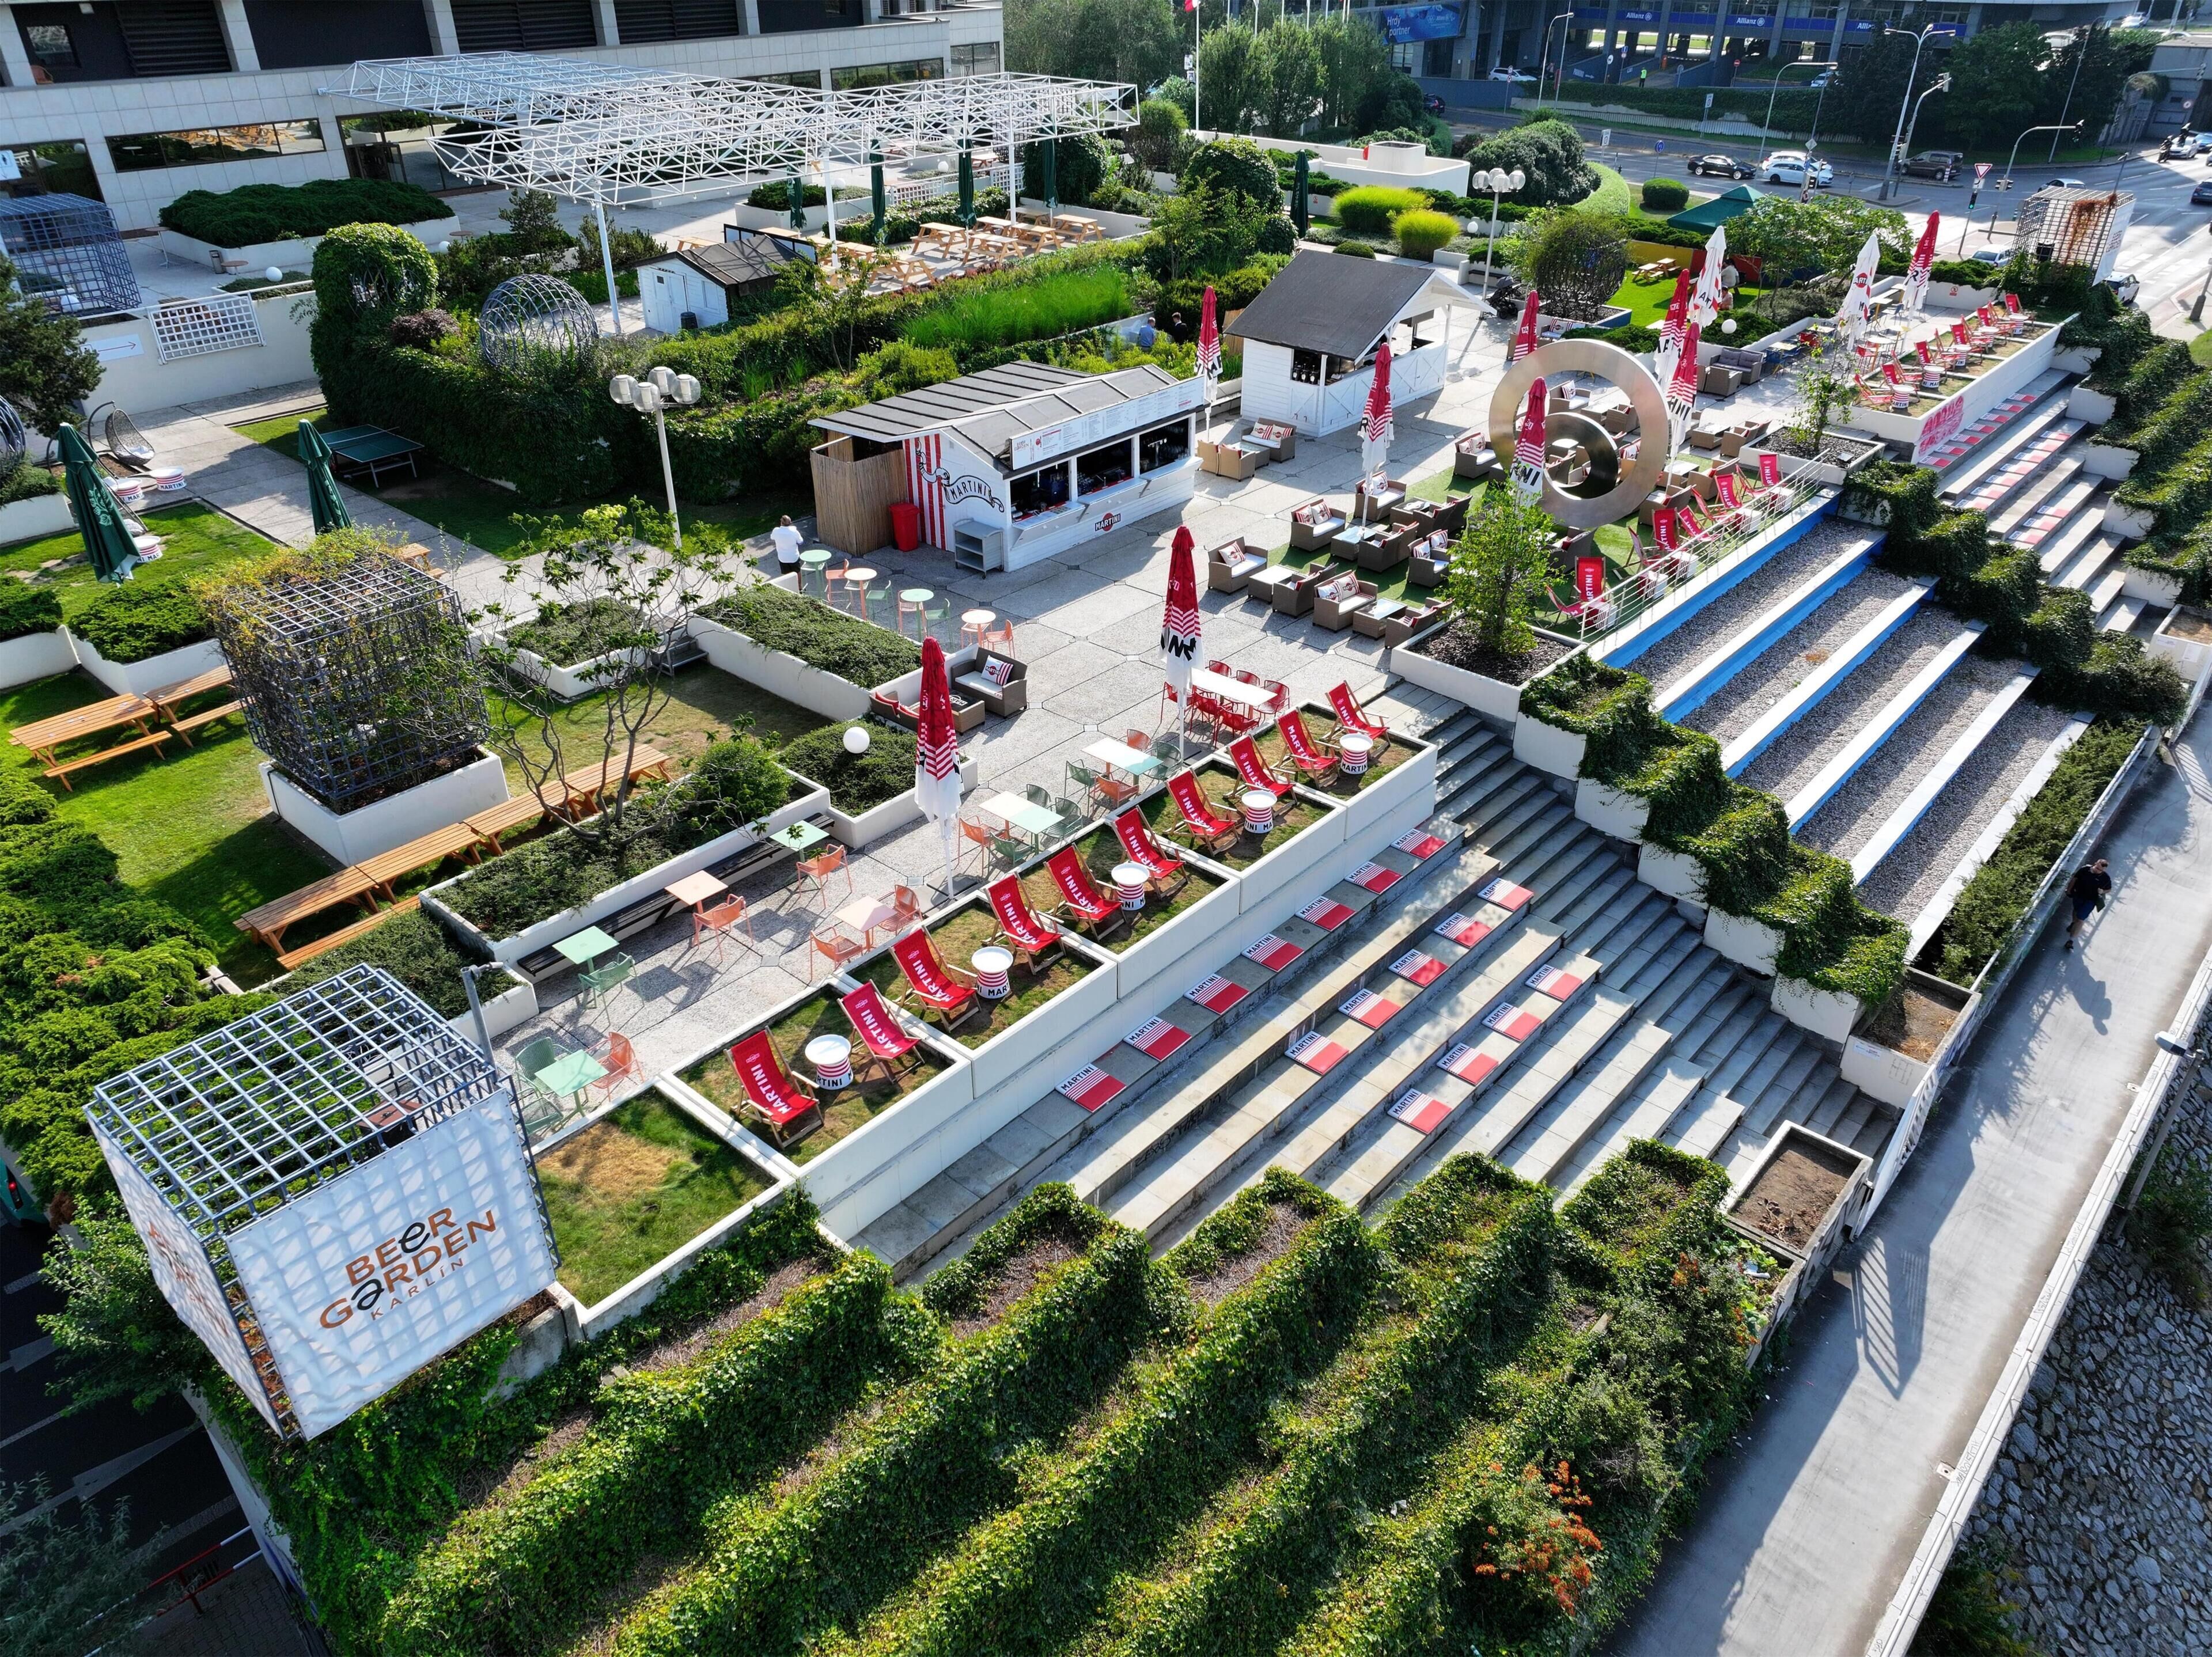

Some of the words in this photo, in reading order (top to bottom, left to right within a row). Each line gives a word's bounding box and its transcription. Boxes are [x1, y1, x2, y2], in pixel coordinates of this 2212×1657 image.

[1387, 15, 1401, 27] Hrdý
[1389, 26, 1410, 37] partner
[950, 480, 986, 500] MARTINI
[1096, 514, 1120, 530] MARTINI
[1585, 574, 1594, 601] ARTINI
[1395, 830, 1418, 846] MARTINI
[1129, 836, 1164, 874] MARTINI
[1349, 863, 1373, 879] MARTINI
[1065, 875, 1102, 915] MARTINI
[1482, 879, 1505, 896] MARTINI
[1300, 897, 1325, 916] MARTINI
[1004, 902, 1039, 945] MARTINI
[1438, 914, 1463, 932] MARTINI
[1247, 935, 1274, 955] MARTINI
[1393, 951, 1419, 970] MARTINI
[912, 960, 954, 1002] MARTINI
[1189, 975, 1218, 996] MARTINI
[1530, 966, 1552, 985] MARTINI
[1343, 991, 1370, 1011] MARTINI
[1487, 1004, 1511, 1024] MARTINI
[861, 1009, 903, 1053] MARTINI
[1129, 1018, 1160, 1041] MARTINI
[1290, 1033, 1318, 1056] MARTINI
[1442, 1045, 1467, 1067] MARTINI
[1061, 1066, 1094, 1091] MARTINI
[751, 1064, 793, 1114] MARTINI
[1393, 1091, 1419, 1114] MARTINI
